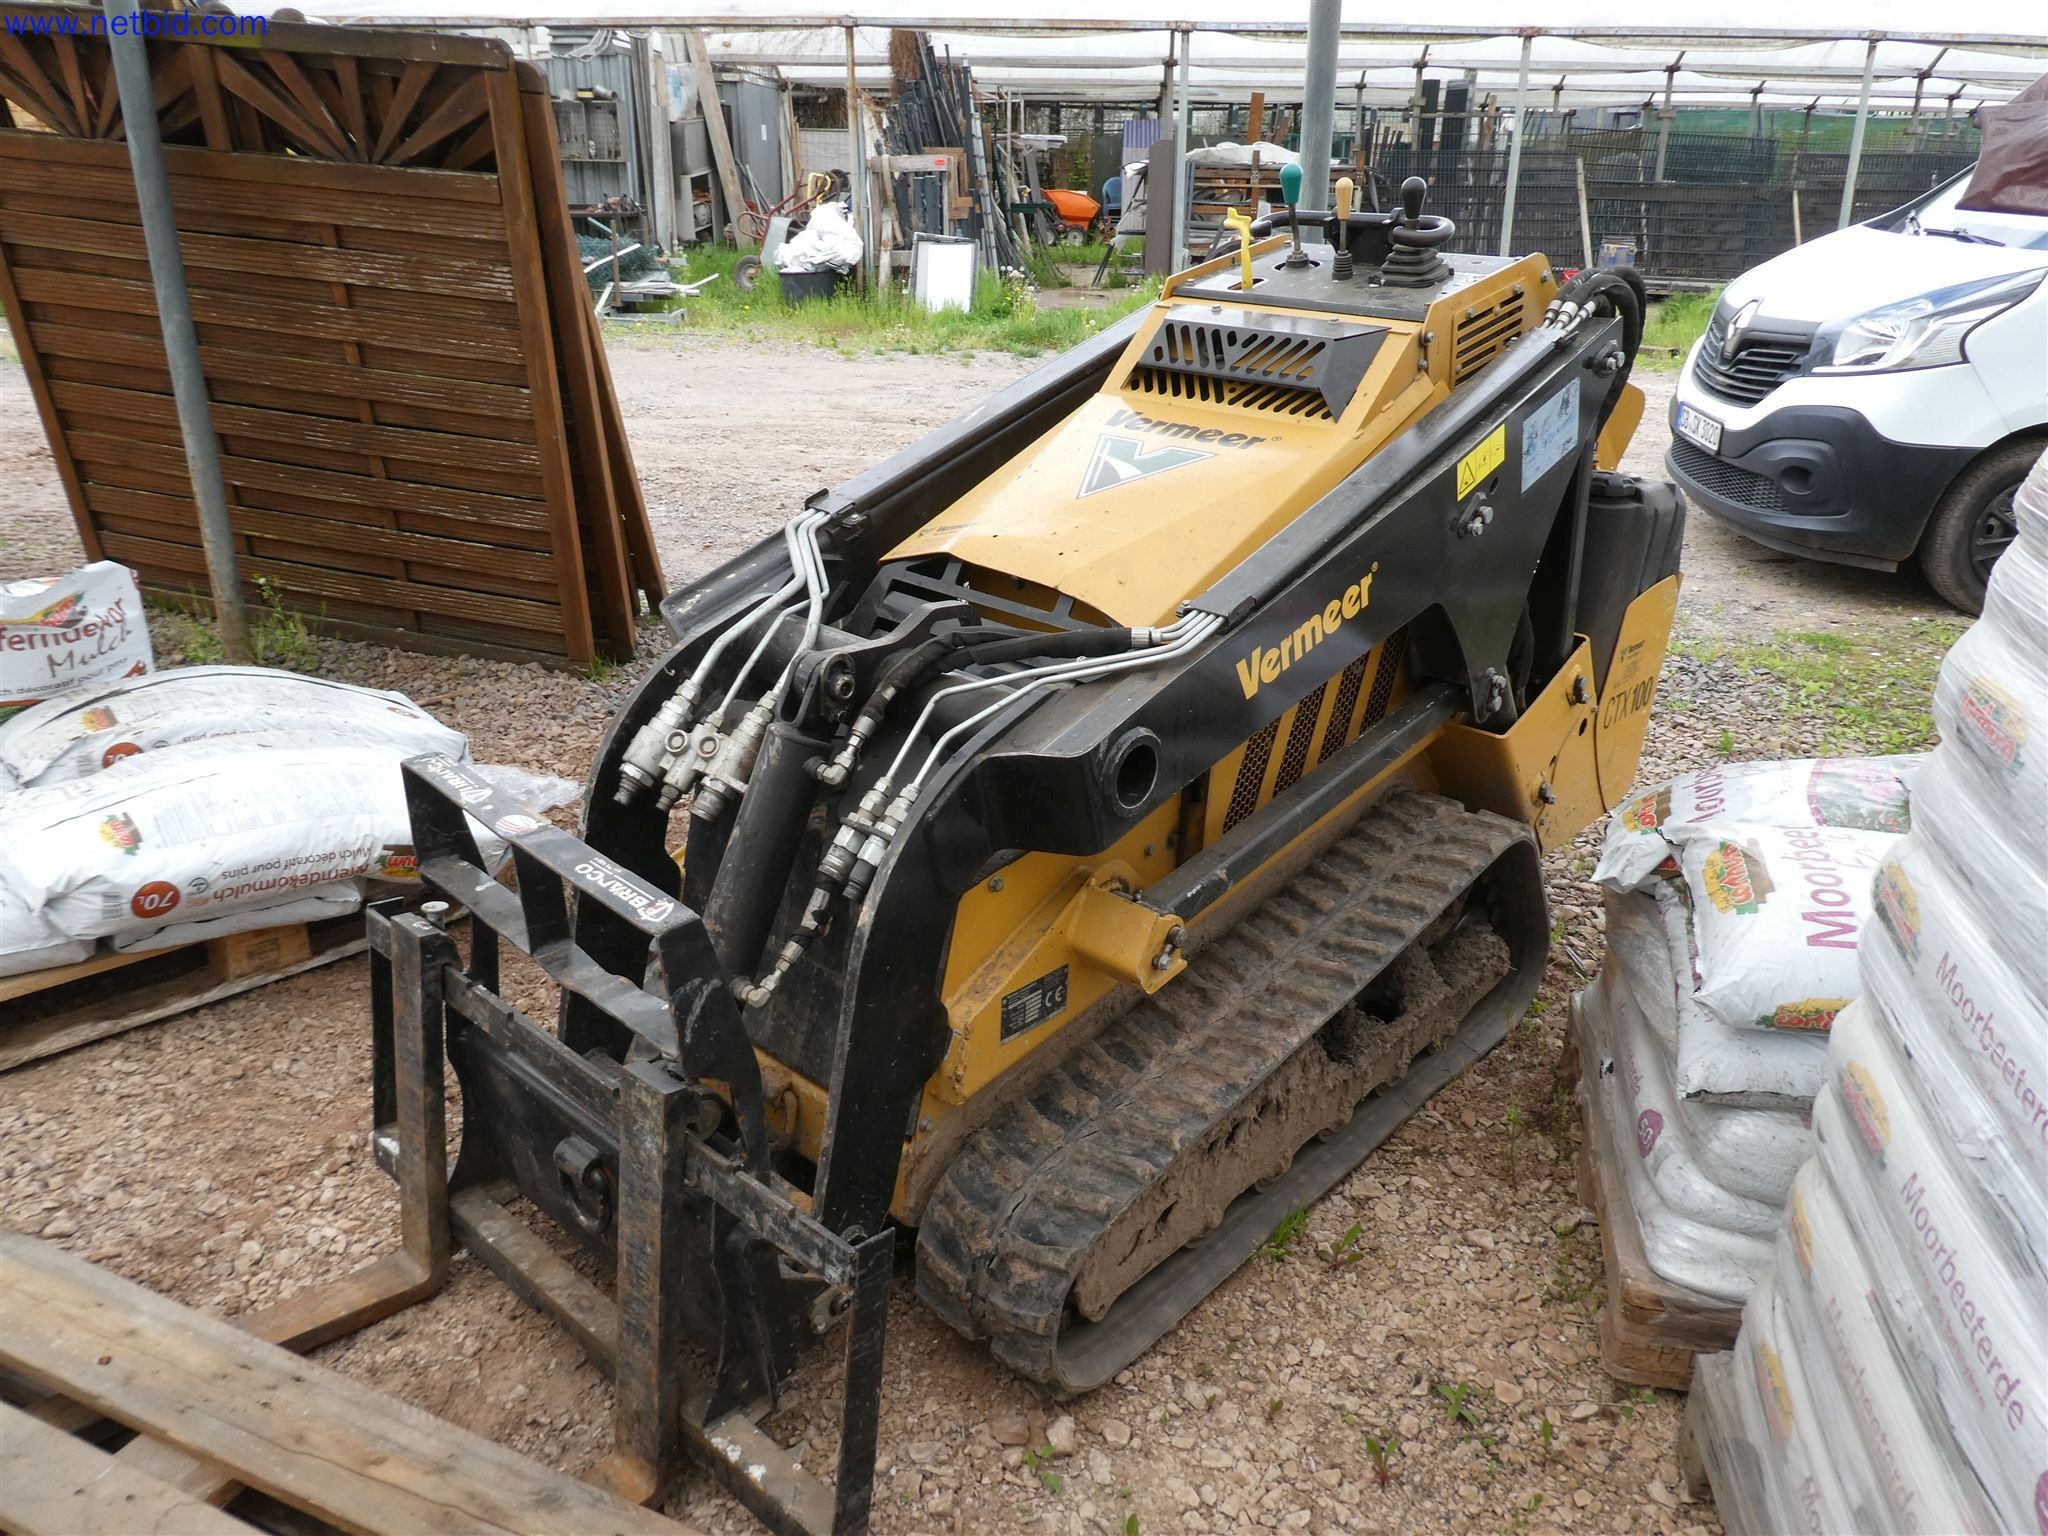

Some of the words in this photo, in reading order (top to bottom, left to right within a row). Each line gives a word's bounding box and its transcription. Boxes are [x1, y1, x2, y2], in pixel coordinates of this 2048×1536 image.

[1105, 409, 1267, 449] Vermeer
[1236, 572, 1372, 700] Vermeer
[221, 865, 249, 880] pins
[252, 861, 281, 874] pour
[284, 851, 336, 871] décoratif
[1901, 1171, 2024, 1431] Moorbeeterde
